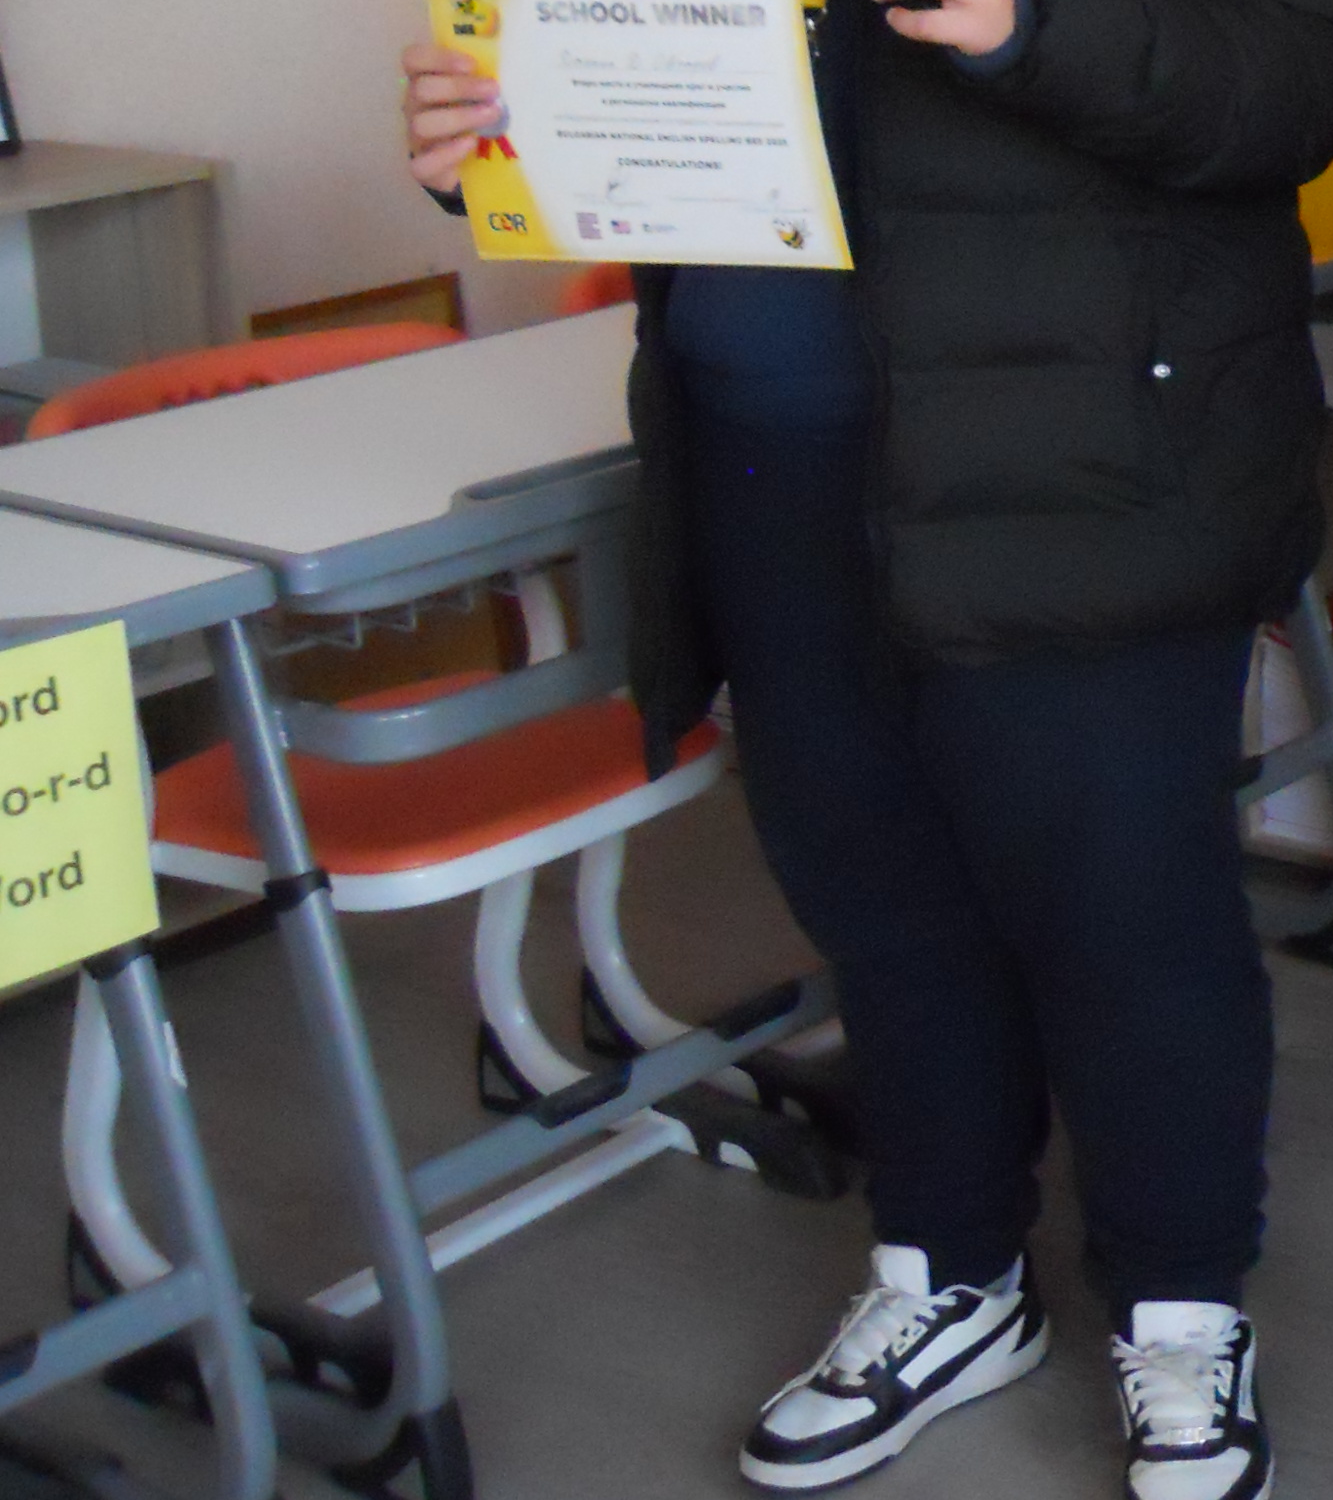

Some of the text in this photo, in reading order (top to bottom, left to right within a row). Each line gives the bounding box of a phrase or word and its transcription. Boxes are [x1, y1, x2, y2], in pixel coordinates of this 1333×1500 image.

[535, 0, 767, 28] SCHOOL WINNER
[0, 850, 84, 907] ord
